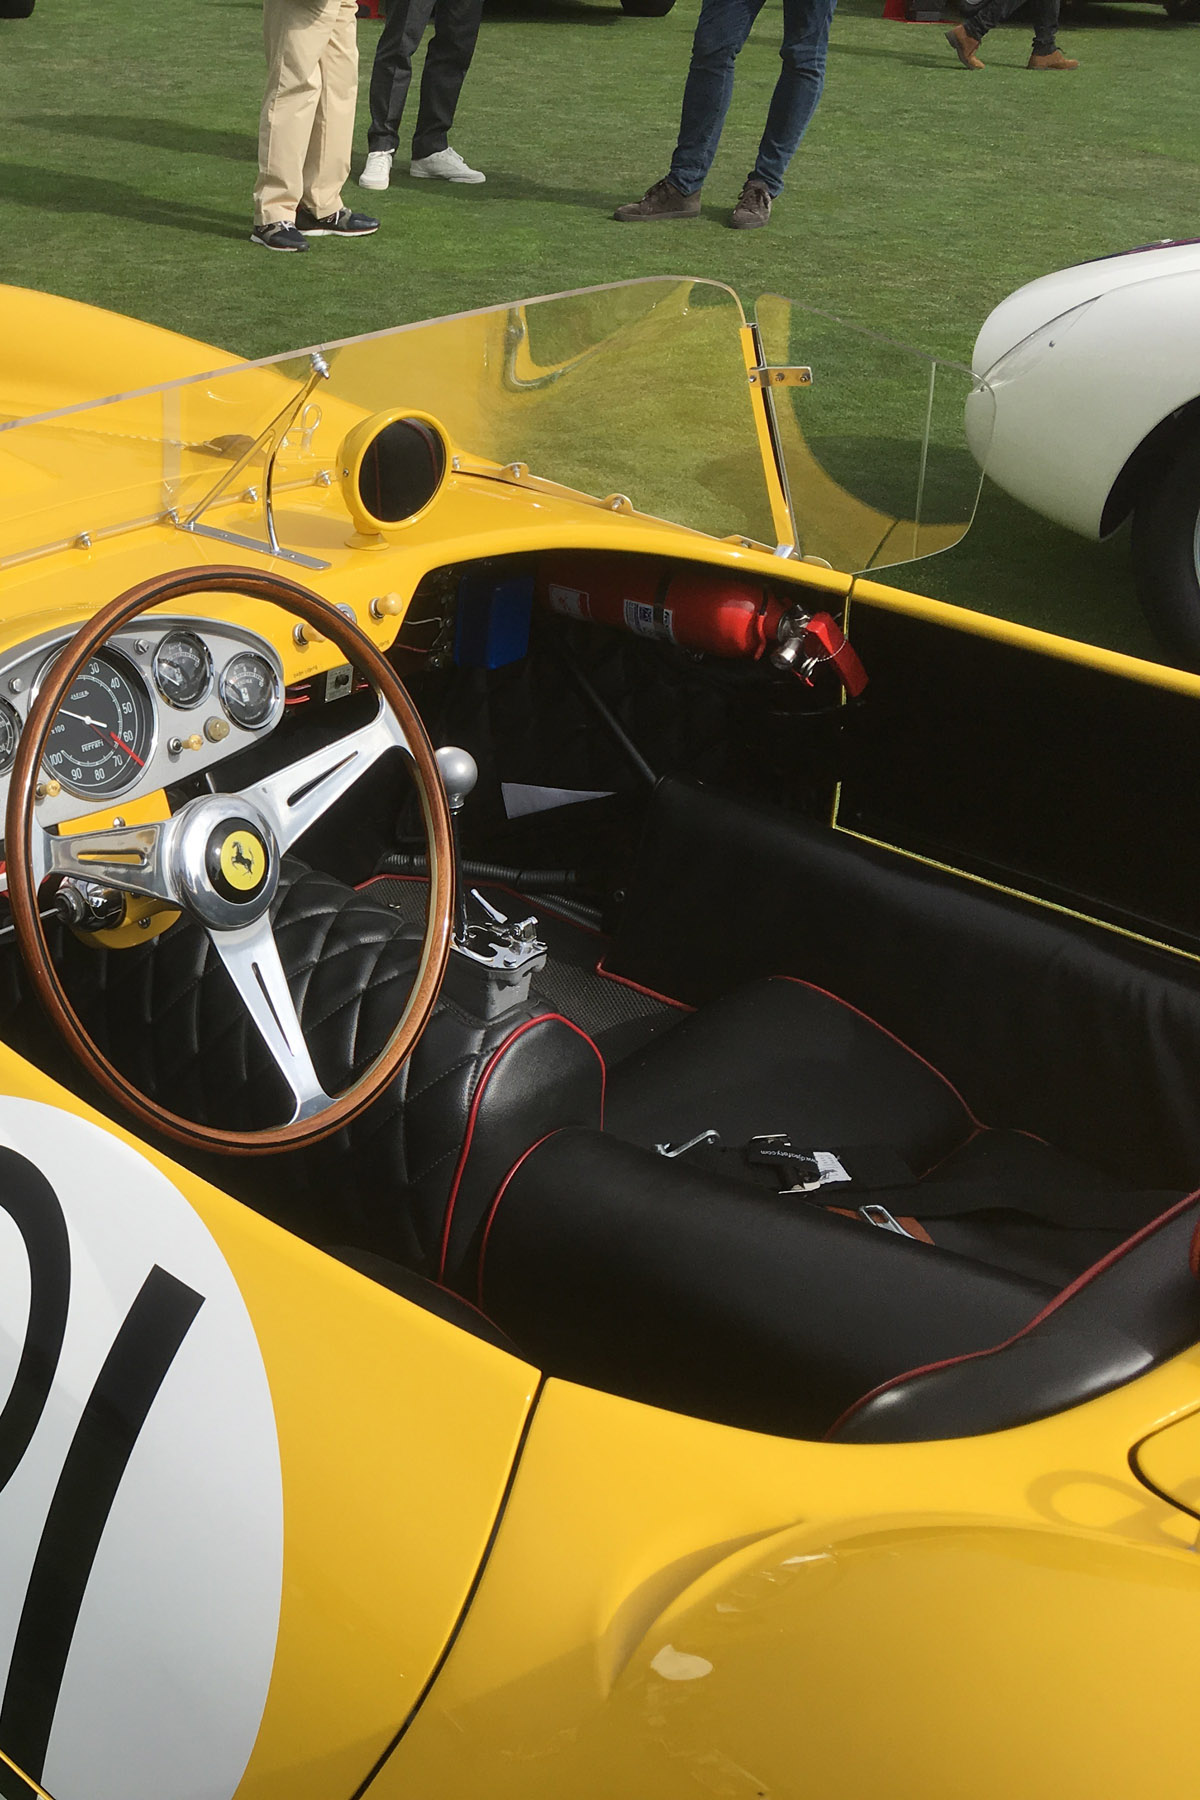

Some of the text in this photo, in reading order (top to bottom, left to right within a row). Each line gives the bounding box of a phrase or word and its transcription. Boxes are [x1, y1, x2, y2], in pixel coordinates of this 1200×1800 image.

[89, 662, 100, 675] 30
[110, 676, 121, 689] 40
[122, 702, 133, 714] 50
[123, 730, 134, 742] 60
[81, 739, 104, 753] Ferrari
[49, 752, 64, 766] 100
[112, 754, 123, 767] 70
[71, 767, 82, 781] 90
[94, 768, 105, 781] 80
